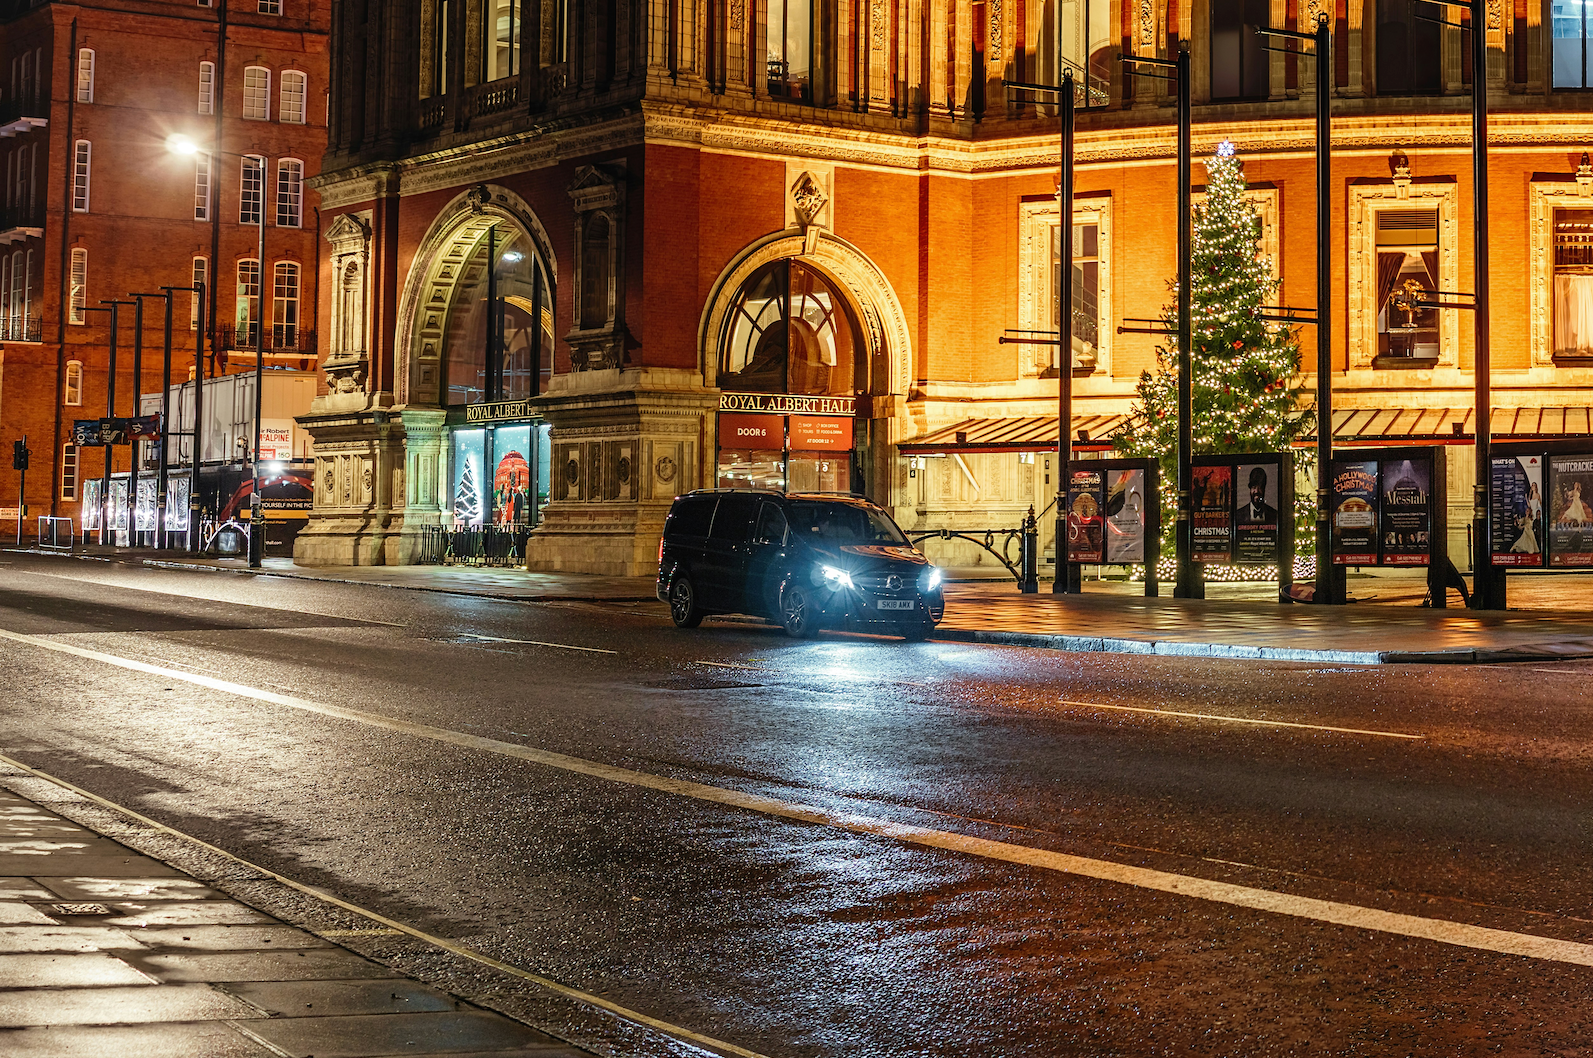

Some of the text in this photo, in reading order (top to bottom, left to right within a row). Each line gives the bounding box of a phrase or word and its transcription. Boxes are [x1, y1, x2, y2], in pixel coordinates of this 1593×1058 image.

[466, 405, 494, 420] ROYAL
[494, 402, 526, 418] ALBERT
[719, 395, 857, 414] ROYAL ALBERT HALL
[737, 428, 767, 437] DOOR 6
[1333, 471, 1377, 485] A HOLLYWOOD
[1335, 479, 1374, 493] CHRISTMAS
[1386, 489, 1427, 505] Messiah
[1193, 511, 1205, 519] GUY
[1193, 527, 1230, 536] CHRISTMAS
